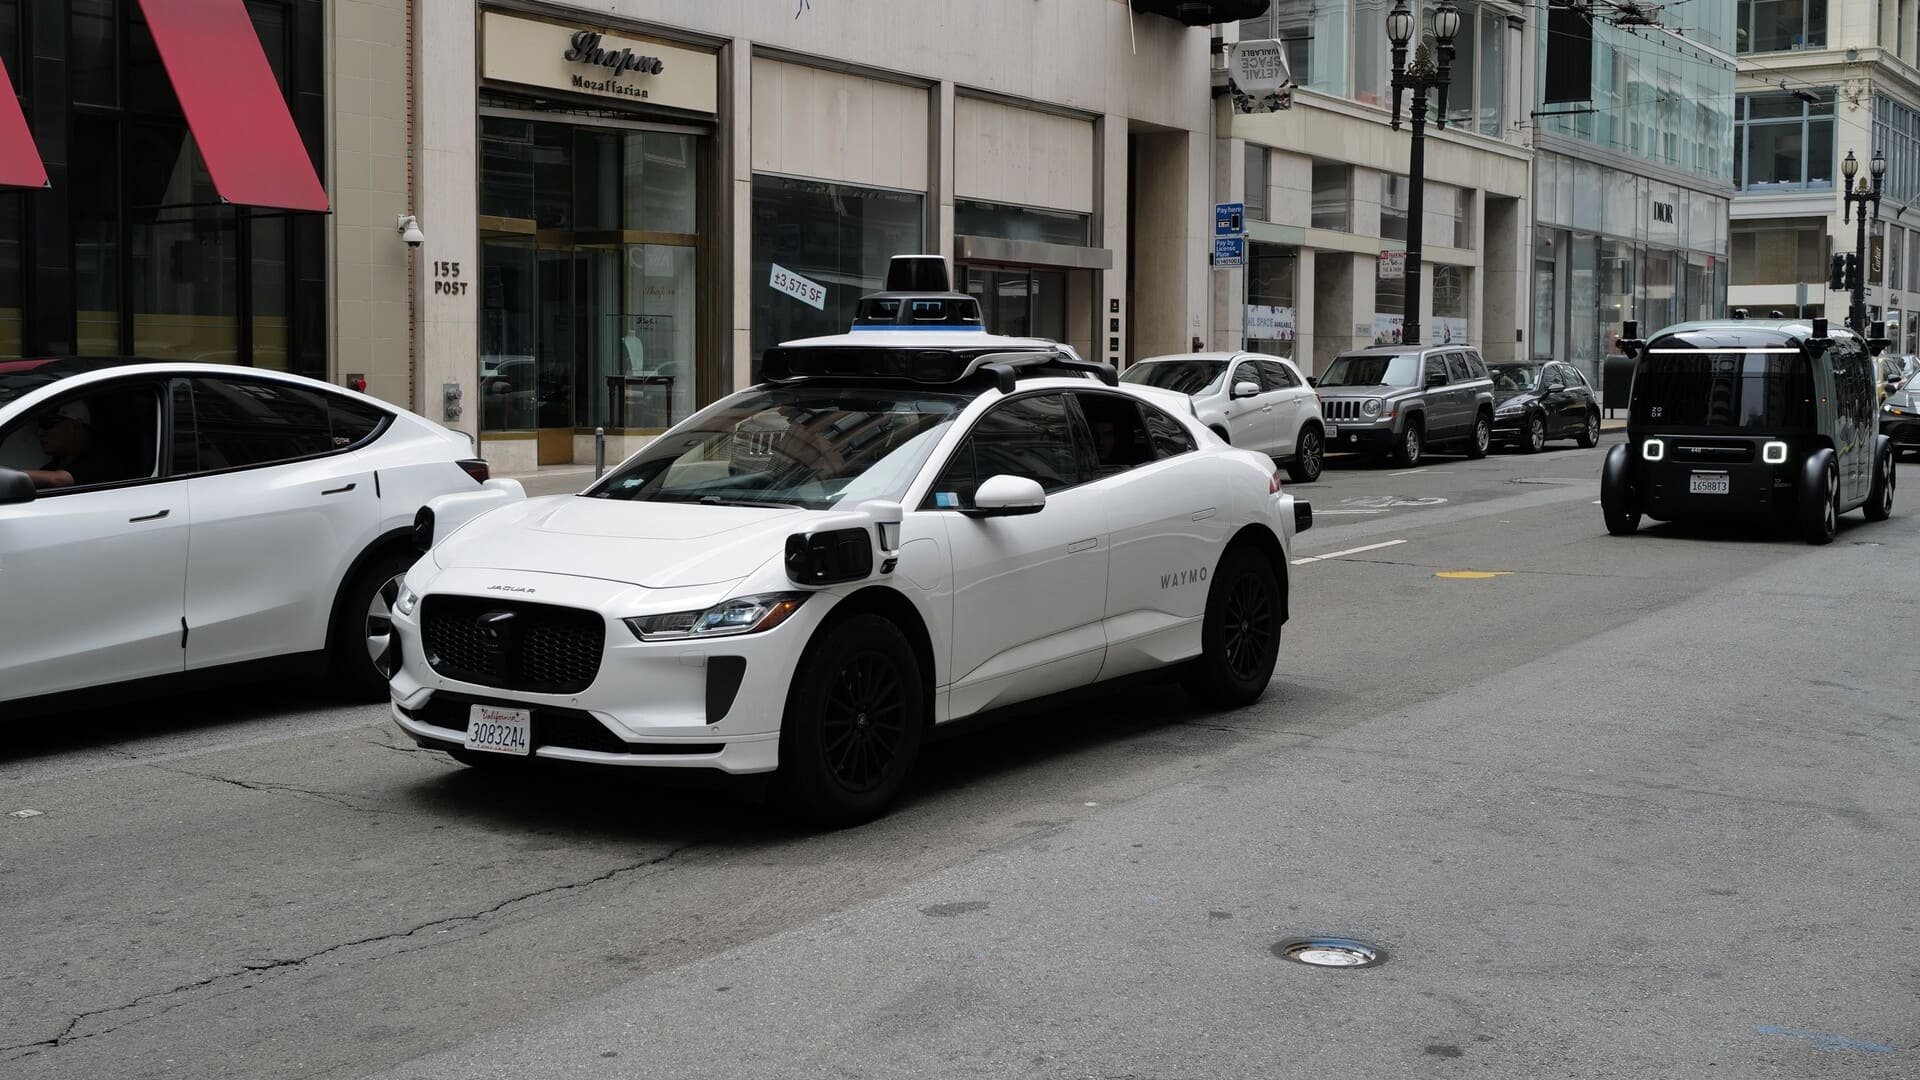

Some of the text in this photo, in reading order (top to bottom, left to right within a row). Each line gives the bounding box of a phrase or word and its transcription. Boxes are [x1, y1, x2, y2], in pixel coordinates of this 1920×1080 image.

[564, 31, 664, 76] Shapur
[1241, 56, 1281, 69] SPACE
[571, 74, 649, 98] Mozaffarian
[1654, 201, 1673, 224] DIOR
[1872, 246, 1881, 272] Cartier
[434, 261, 460, 277] 155
[435, 281, 468, 296] POST
[809, 287, 822, 302] SF
[1257, 317, 1274, 327] SPACE
[1161, 567, 1207, 589] WAYMO
[487, 585, 536, 593] JAGUAR
[482, 710, 516, 722] California
[471, 722, 525, 748] 30832A4
